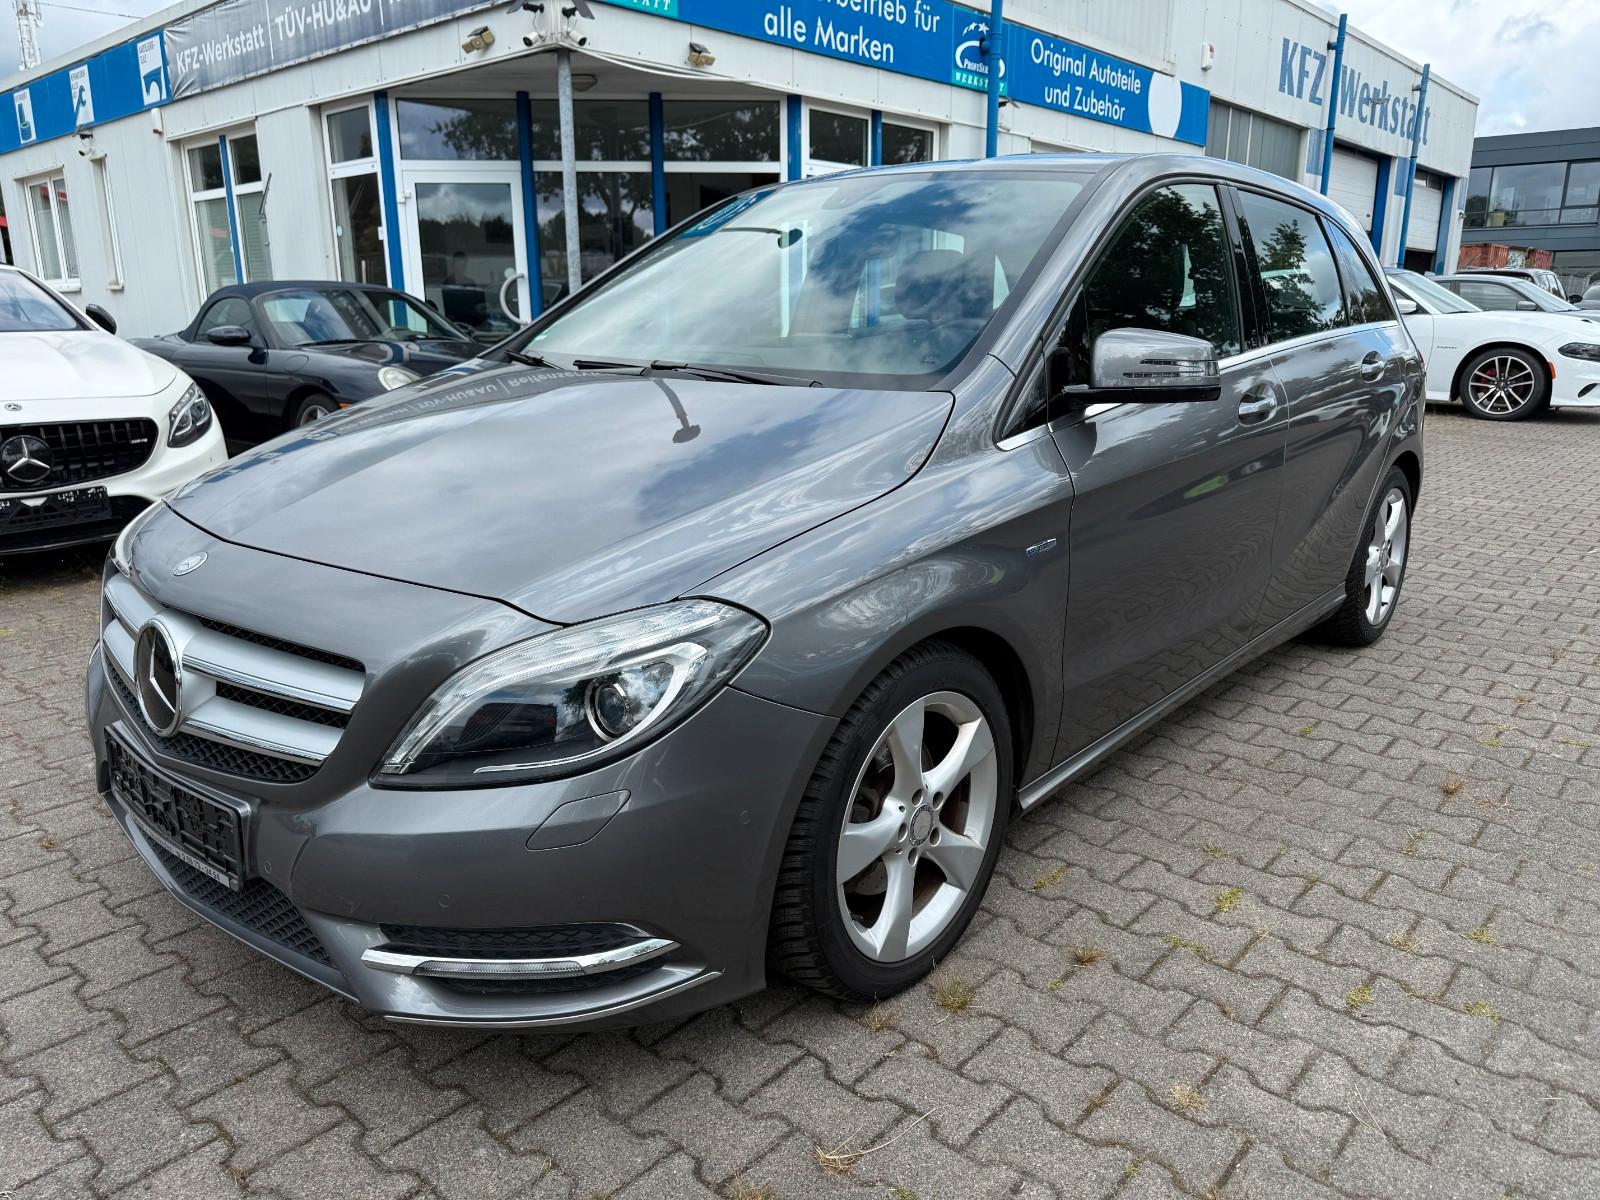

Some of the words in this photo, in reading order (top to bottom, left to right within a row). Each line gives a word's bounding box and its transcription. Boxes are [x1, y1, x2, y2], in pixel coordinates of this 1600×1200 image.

[764, 5, 807, 43] alle
[814, 15, 894, 64] Marken
[914, 0, 940, 33] für
[176, 23, 265, 75] KFZ-Werkstatt
[1031, 38, 1086, 78] Original
[1089, 58, 1141, 95] Autoteile
[955, 71, 1005, 92] WERKSTT
[1044, 83, 1070, 107] und
[1073, 86, 1126, 121] Zubehör
[1278, 37, 1327, 106] KFZ
[1340, 64, 1431, 146] Werkstat
